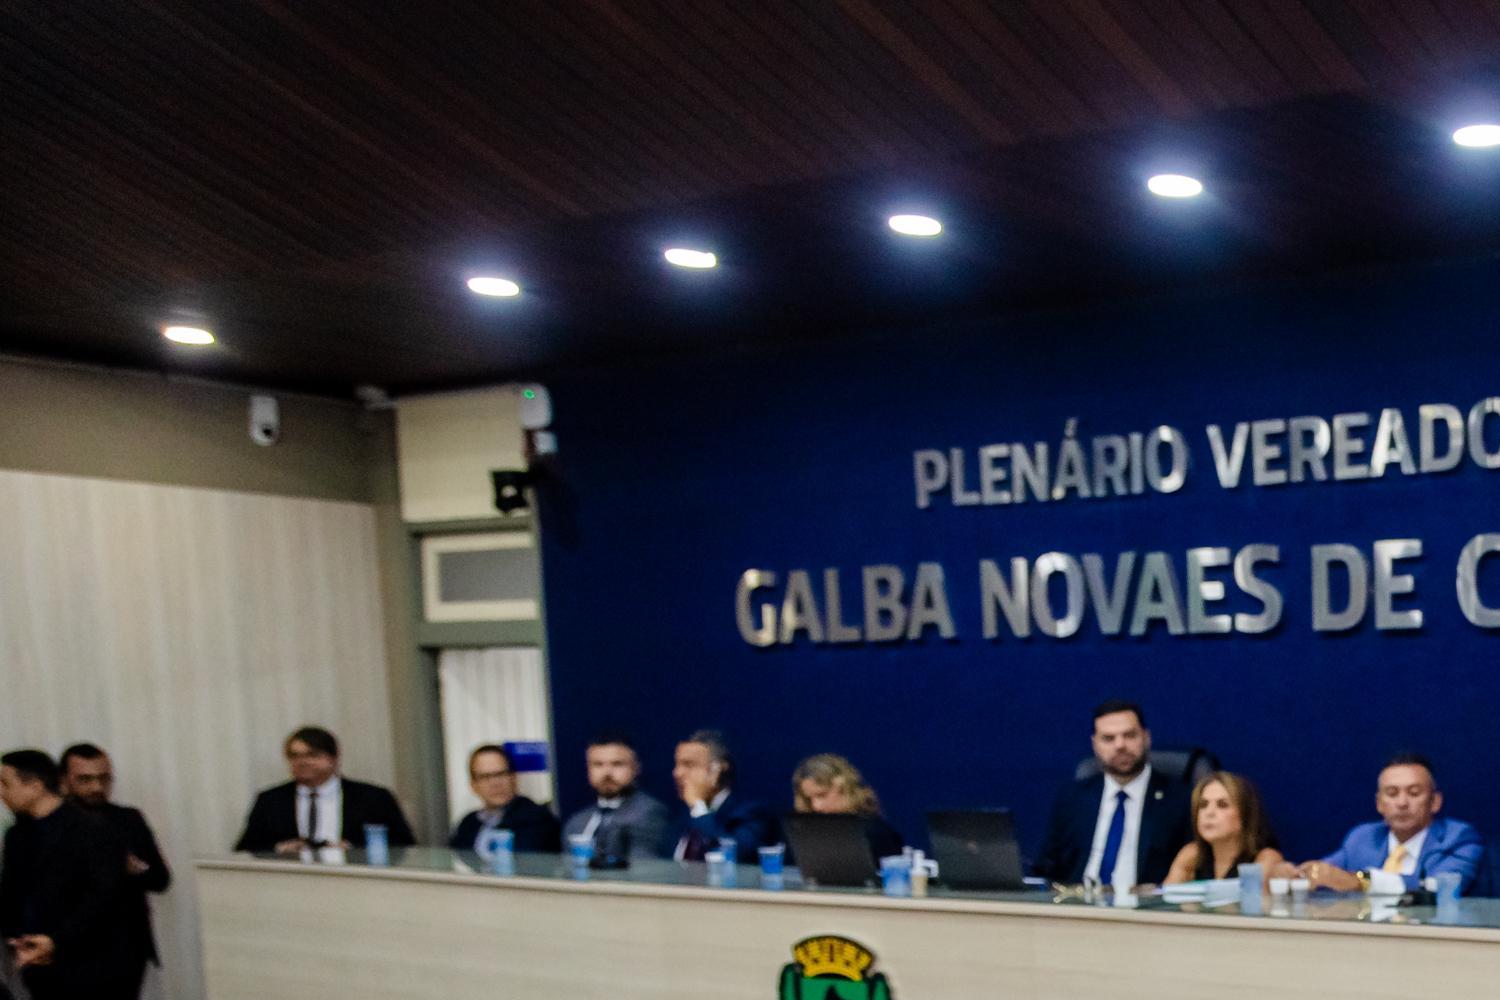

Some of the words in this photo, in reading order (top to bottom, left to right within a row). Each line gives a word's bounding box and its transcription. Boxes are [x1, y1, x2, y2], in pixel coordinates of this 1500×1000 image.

[913, 420, 1187, 508] PLENÁRIO
[736, 560, 955, 647] GALBA
[980, 544, 1284, 638] NOVAES
[1311, 539, 1425, 631] DE
